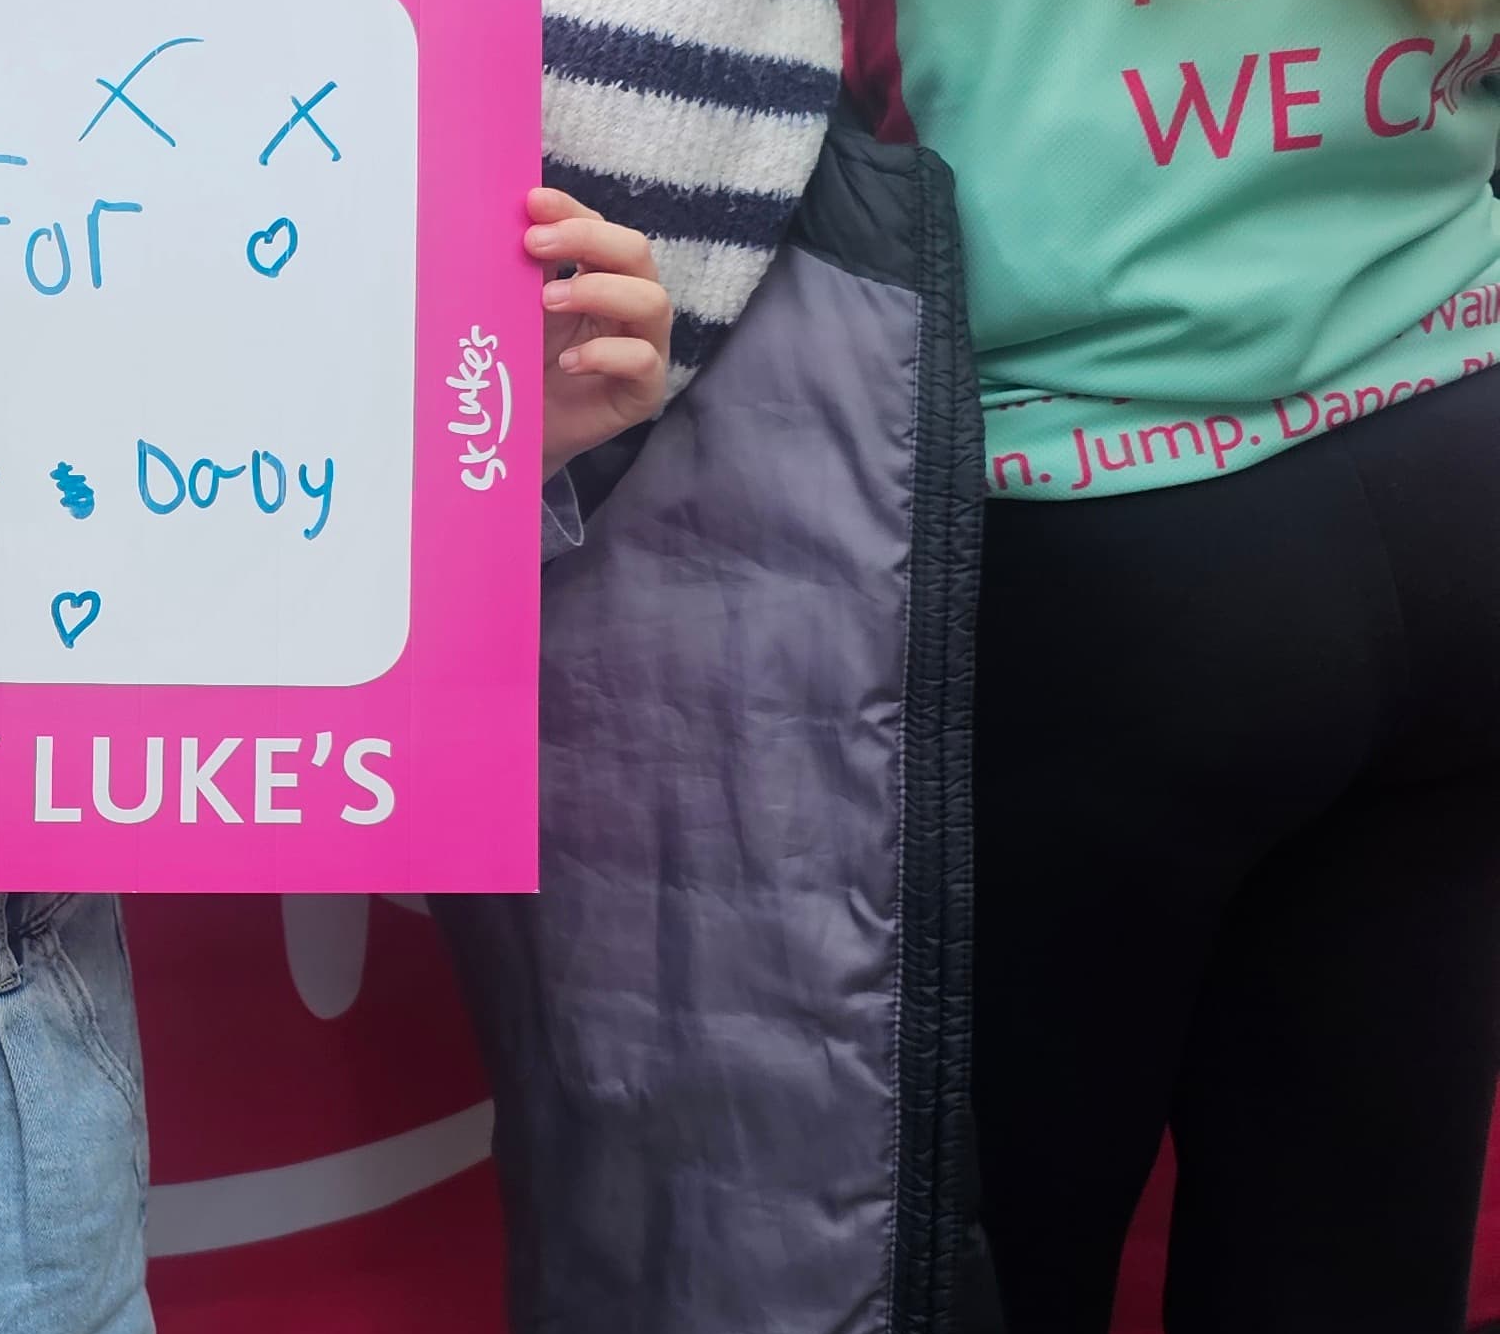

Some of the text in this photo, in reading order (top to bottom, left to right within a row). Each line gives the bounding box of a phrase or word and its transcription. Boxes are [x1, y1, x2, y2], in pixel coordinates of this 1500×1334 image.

[1121, 47, 1323, 167] WE
[1420, 283, 1500, 334] Wal
[1071, 413, 1261, 490] Jump.
[34, 730, 395, 825] LUKE'S
